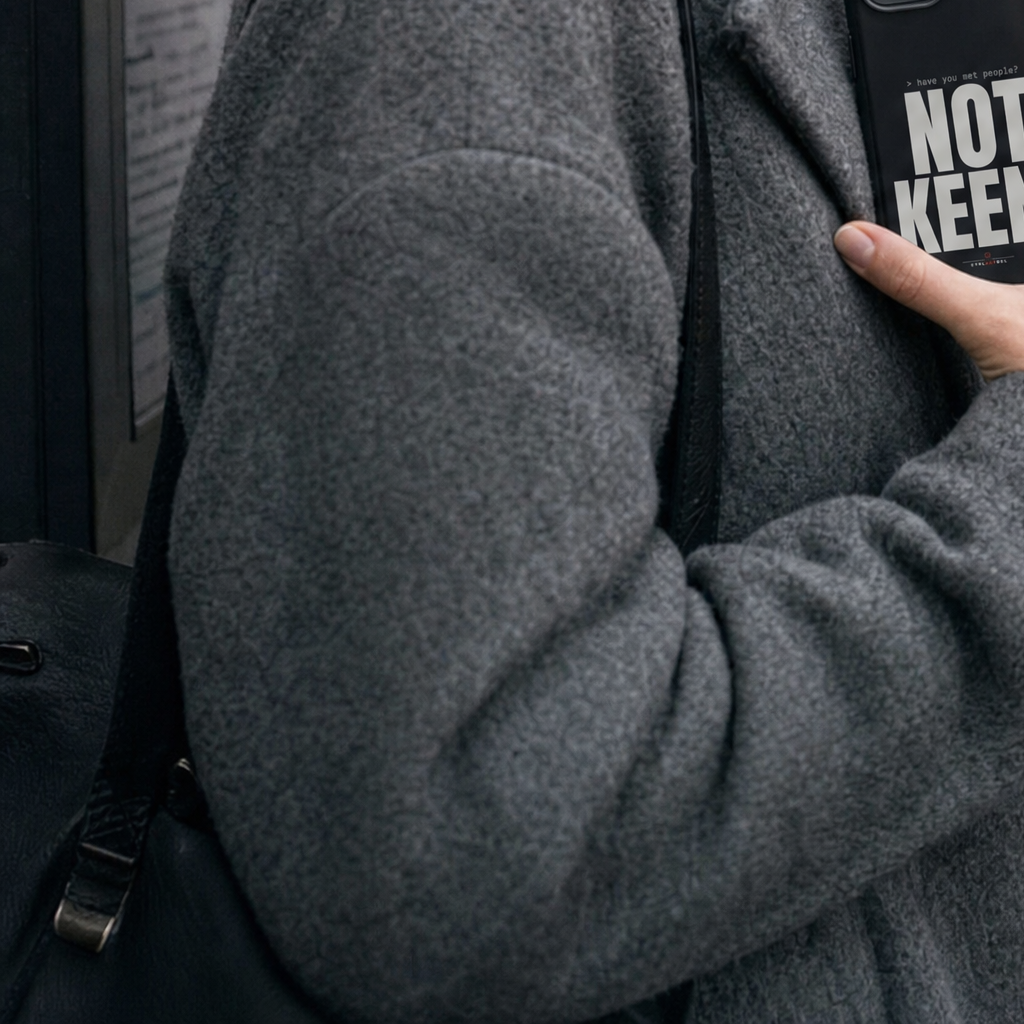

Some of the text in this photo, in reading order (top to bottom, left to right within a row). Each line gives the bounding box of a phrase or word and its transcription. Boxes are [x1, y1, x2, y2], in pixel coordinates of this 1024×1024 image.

[916, 78, 937, 87] have
[942, 75, 958, 85] you
[962, 72, 978, 81] met
[982, 65, 1019, 79] people?
